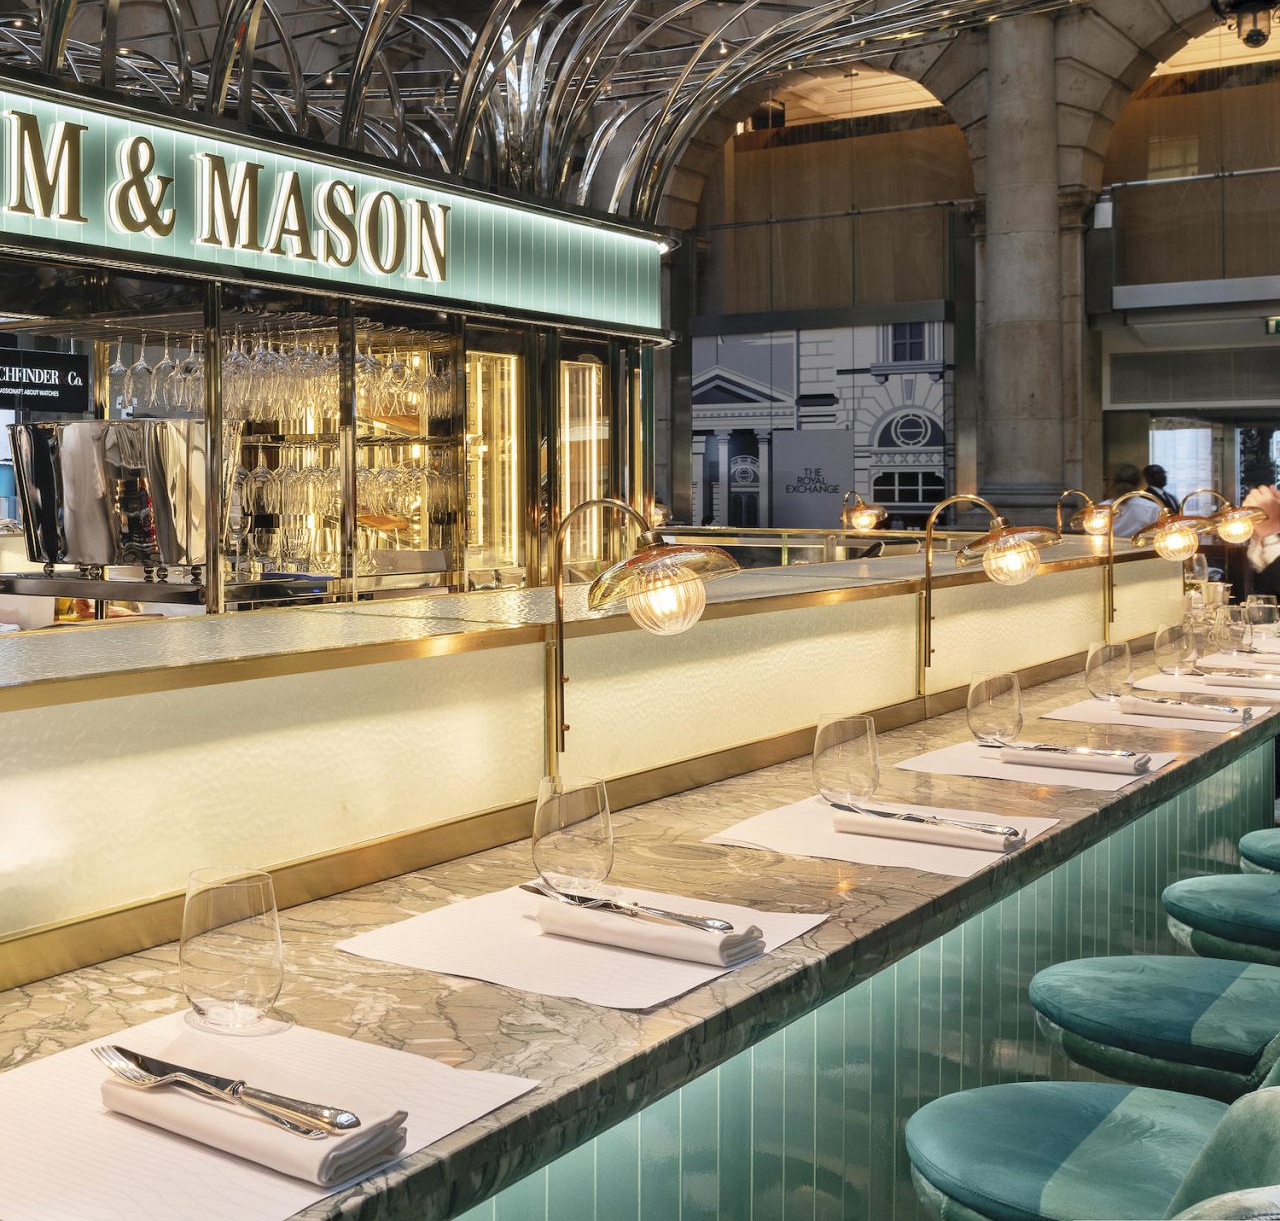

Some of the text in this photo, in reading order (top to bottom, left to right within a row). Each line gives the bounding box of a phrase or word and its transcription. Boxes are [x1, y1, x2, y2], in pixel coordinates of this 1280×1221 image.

[109, 135, 176, 238] &
[195, 152, 451, 282] MASON
[67, 371, 83, 386] Co.
[803, 468, 823, 476] THE
[797, 476, 828, 485] ROYAL
[785, 485, 840, 493] EXCHANGE
